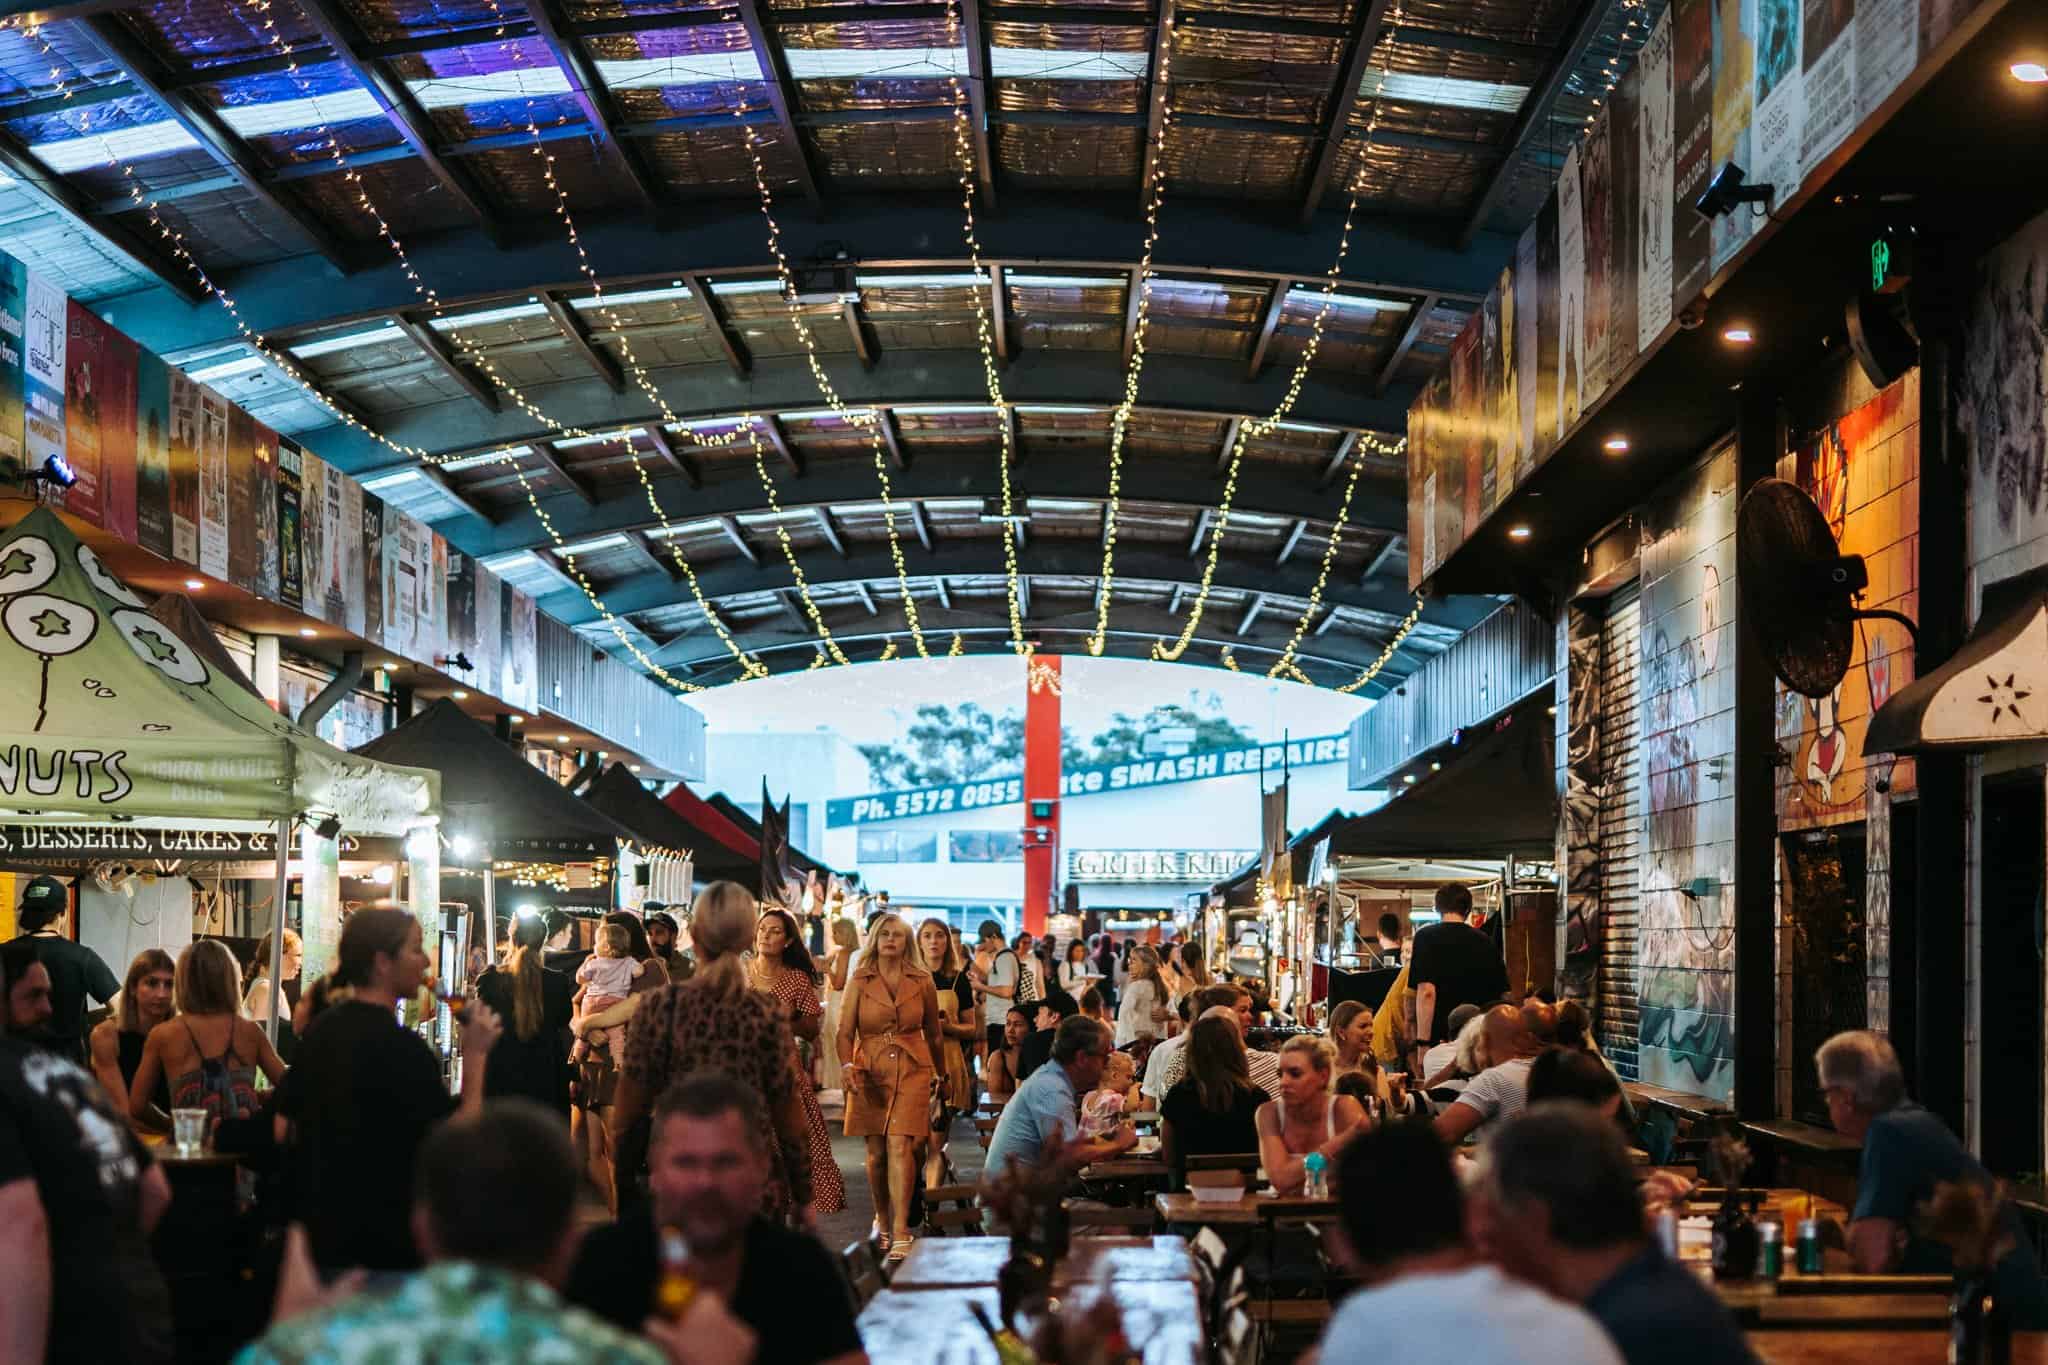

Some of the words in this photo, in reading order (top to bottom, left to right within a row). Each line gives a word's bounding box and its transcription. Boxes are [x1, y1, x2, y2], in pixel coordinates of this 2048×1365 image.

[1109, 754, 1217, 788] SMASH
[1223, 737, 1349, 774] REPAIRS
[852, 798, 891, 821] Ph.
[894, 788, 955, 817] 5572
[961, 779, 1022, 807] 0855
[160, 830, 241, 850] CAKES
[249, 832, 268, 850] &
[1078, 854, 1176, 875] GREEK
